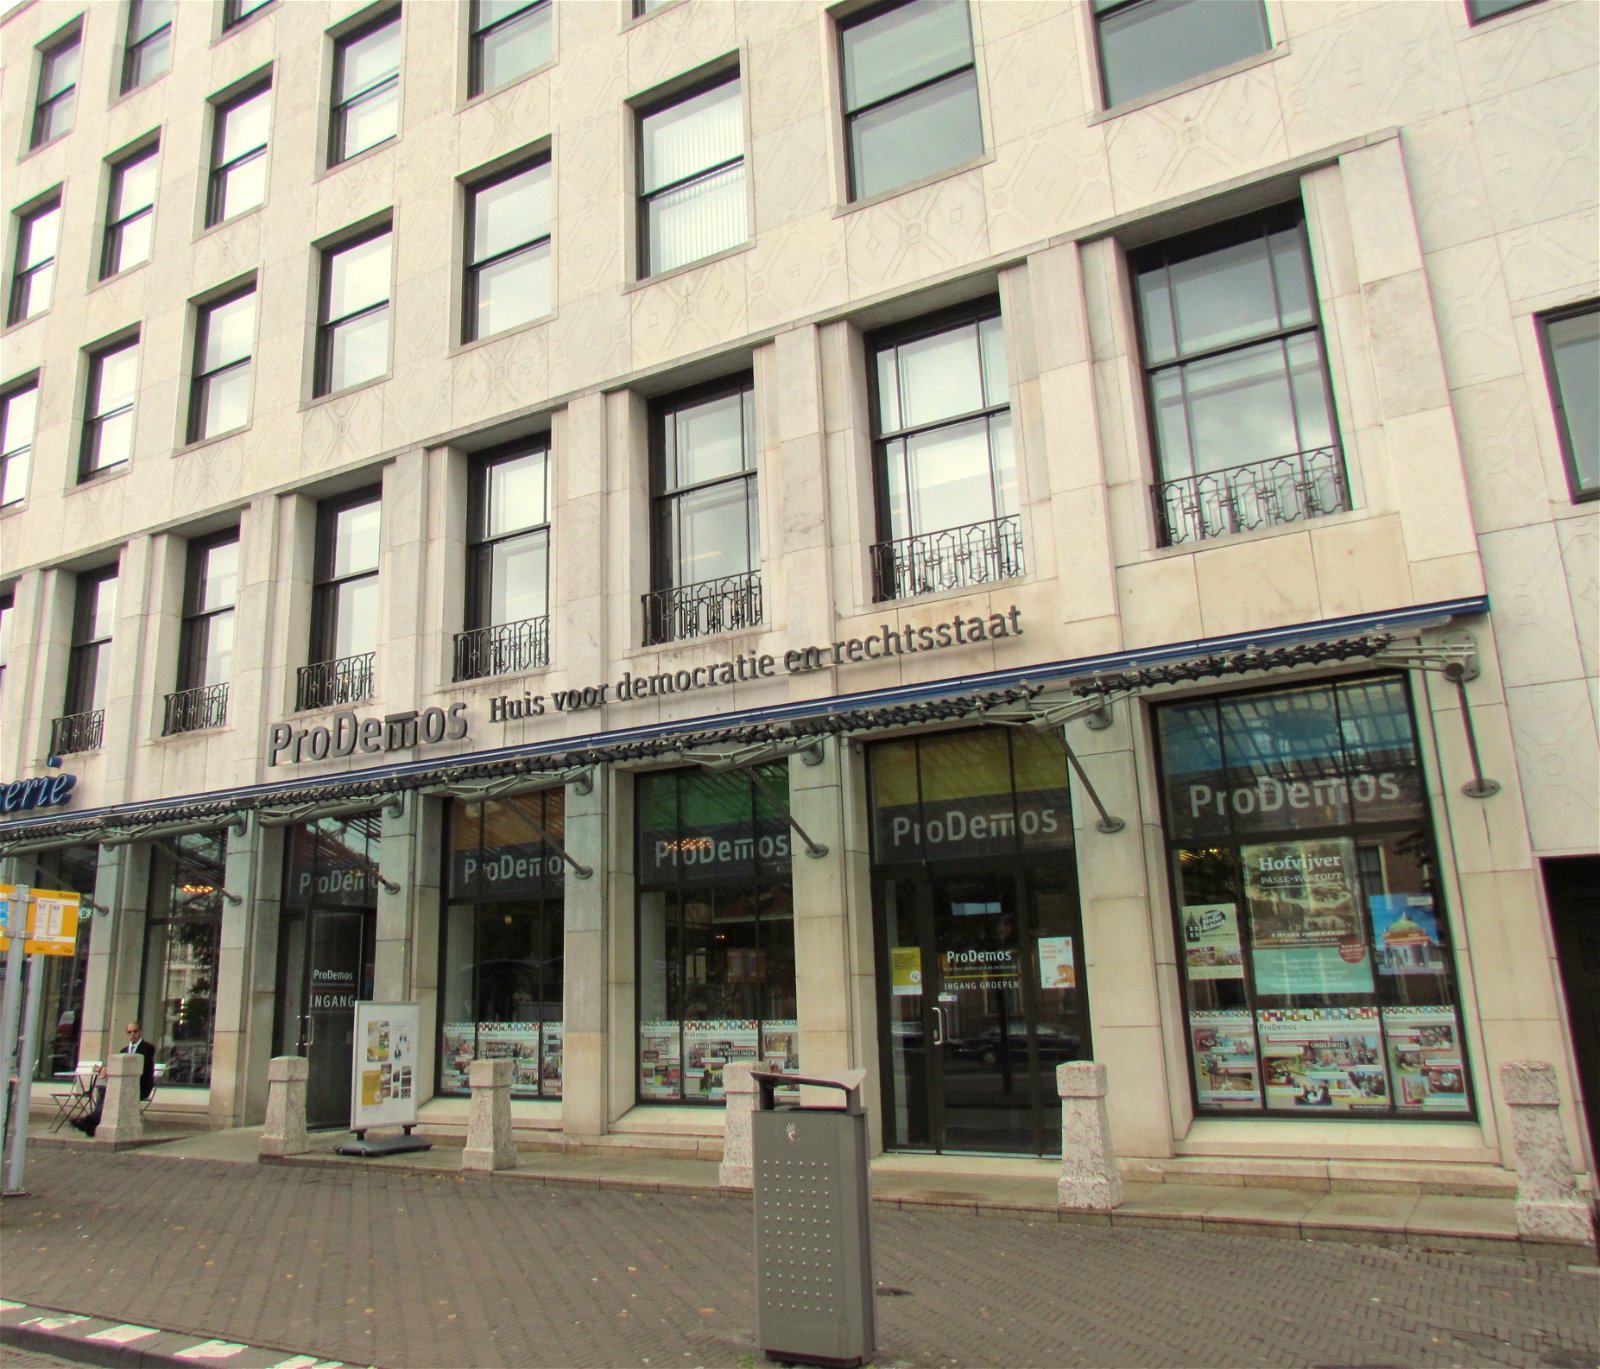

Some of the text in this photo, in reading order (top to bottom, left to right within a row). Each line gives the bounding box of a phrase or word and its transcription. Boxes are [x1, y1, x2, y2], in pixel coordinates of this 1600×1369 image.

[489, 604, 1023, 723] Huis voor democratie en rechtsstaat
[268, 702, 468, 767] ProDemos
[0, 755, 77, 814] erie
[1189, 772, 1400, 818] ProDemos
[893, 809, 1058, 847] ProDemos
[655, 834, 789, 868] ProDemos
[1259, 853, 1341, 872] Hofvijver
[946, 949, 1012, 963] ProDemos
[313, 969, 353, 980] ProDemos
[944, 980, 1020, 990] INGANG GROEPEN
